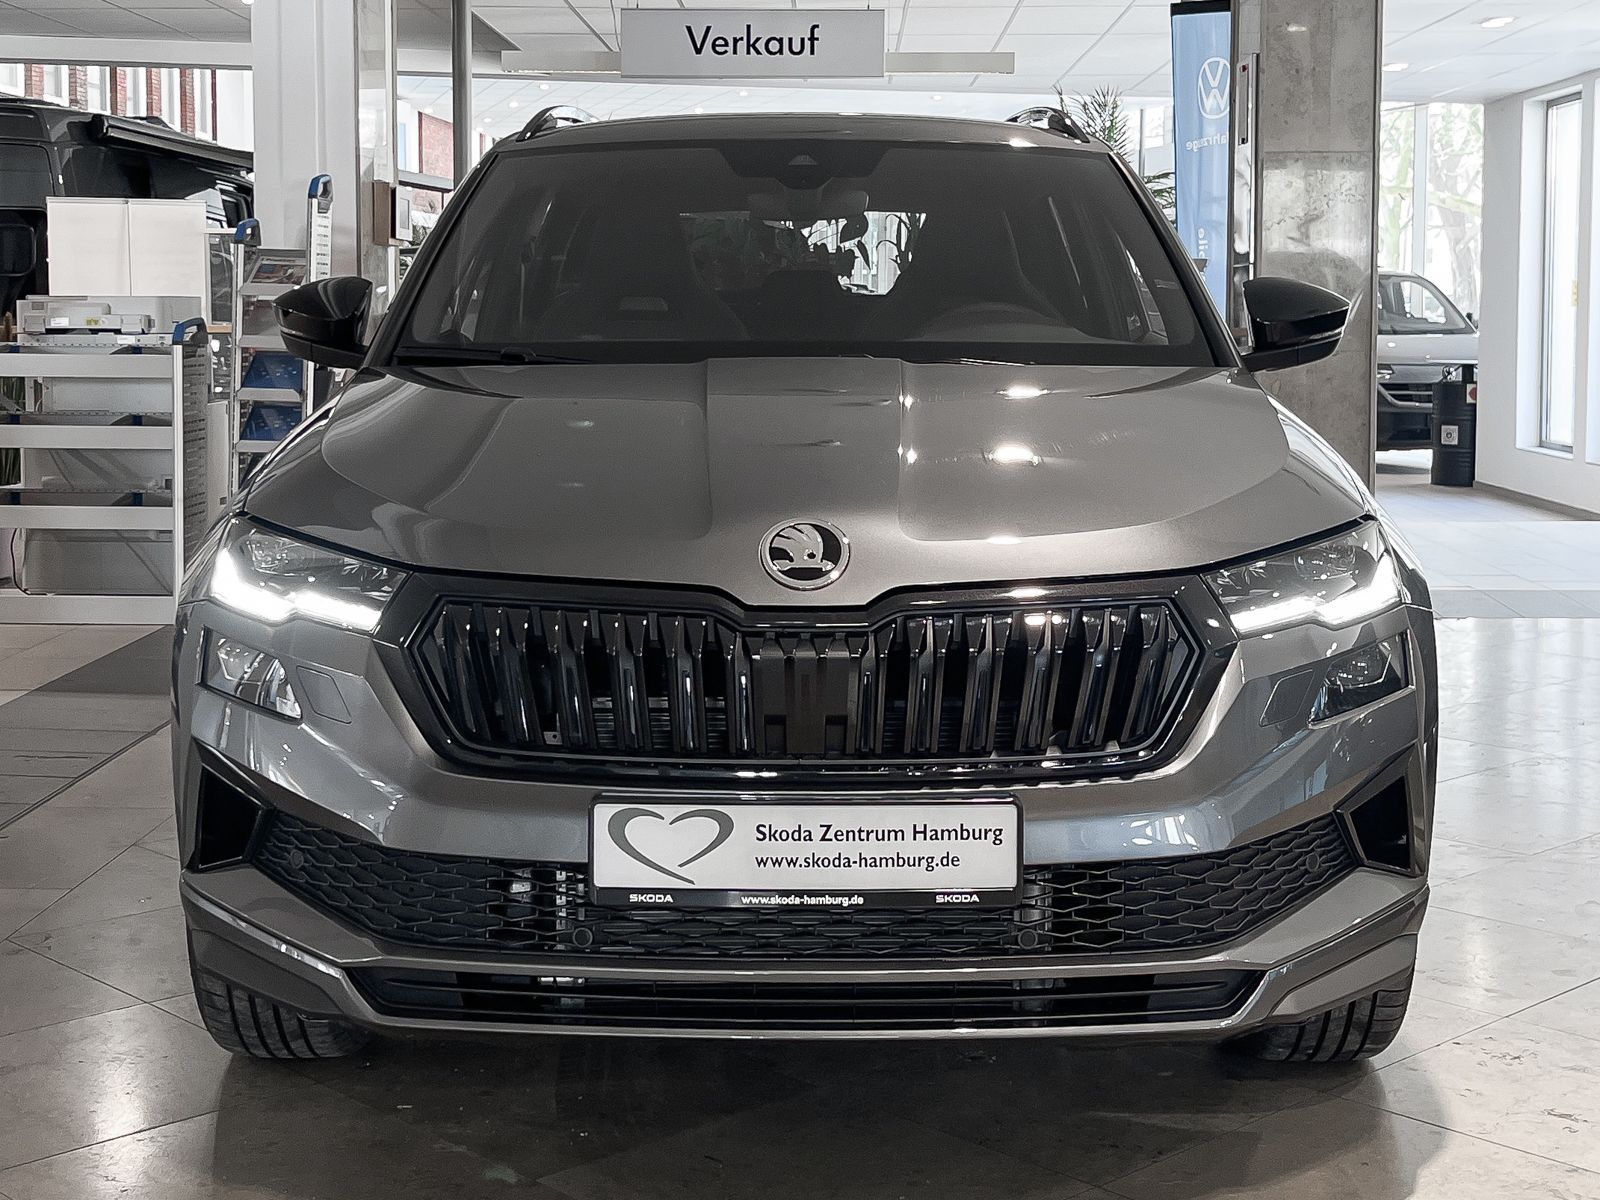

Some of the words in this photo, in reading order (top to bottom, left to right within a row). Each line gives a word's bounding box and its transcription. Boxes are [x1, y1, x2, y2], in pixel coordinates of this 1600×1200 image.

[685, 23, 820, 56] Verkauf
[755, 823, 814, 842] Skoda
[818, 823, 905, 842] Zentrum
[912, 823, 1004, 846] Hamburg
[754, 851, 961, 872] www.skoda-hamburg.de
[629, 893, 674, 903] SKODA
[740, 894, 865, 907] www.skoda-hamburg.de
[935, 893, 980, 904] SKODA
